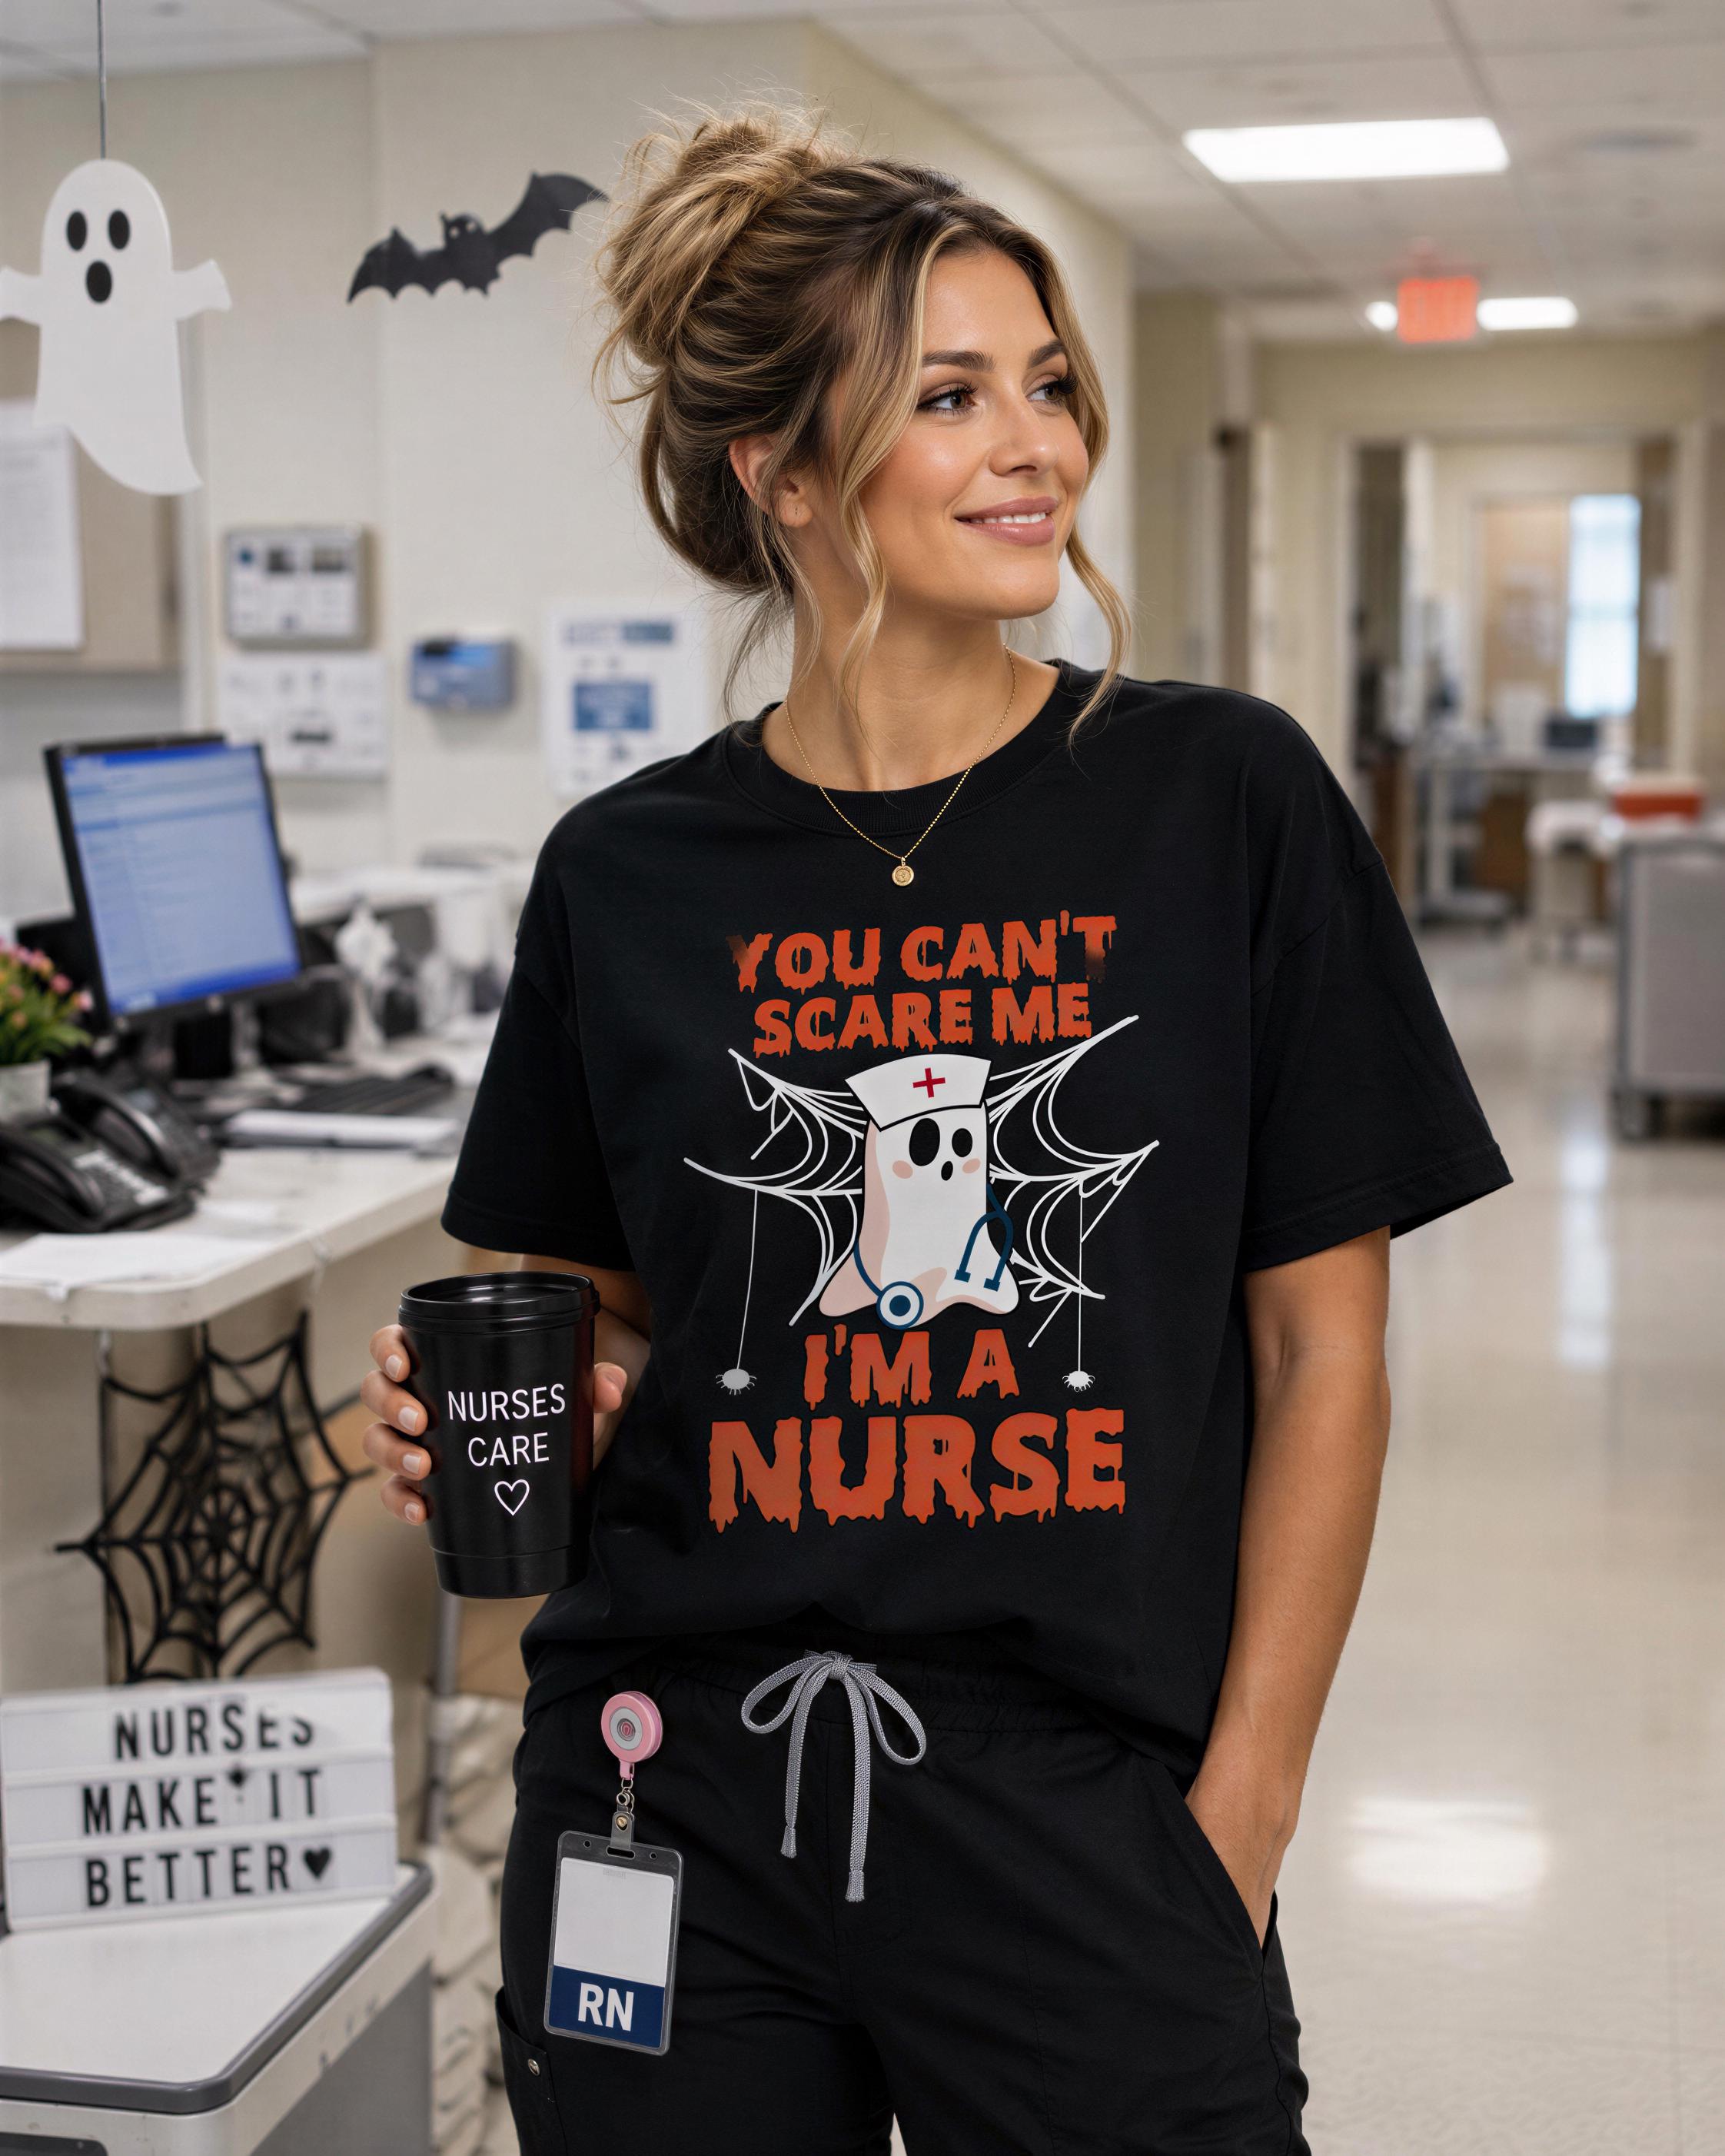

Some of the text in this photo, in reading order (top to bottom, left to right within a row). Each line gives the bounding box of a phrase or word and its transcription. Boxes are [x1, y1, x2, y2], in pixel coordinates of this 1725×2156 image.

[726, 910, 1118, 995] YOU CAN'T
[753, 983, 1092, 1059] SCARE ME
[804, 1323, 1019, 1411] I'M A
[447, 1383, 566, 1422] NURSES
[467, 1432, 550, 1467] CARE
[709, 1407, 1126, 1534] NURSE
[82, 1768, 321, 1835] MAKE IT
[85, 1843, 291, 1908] BETTER
[577, 1981, 634, 2032] RN
